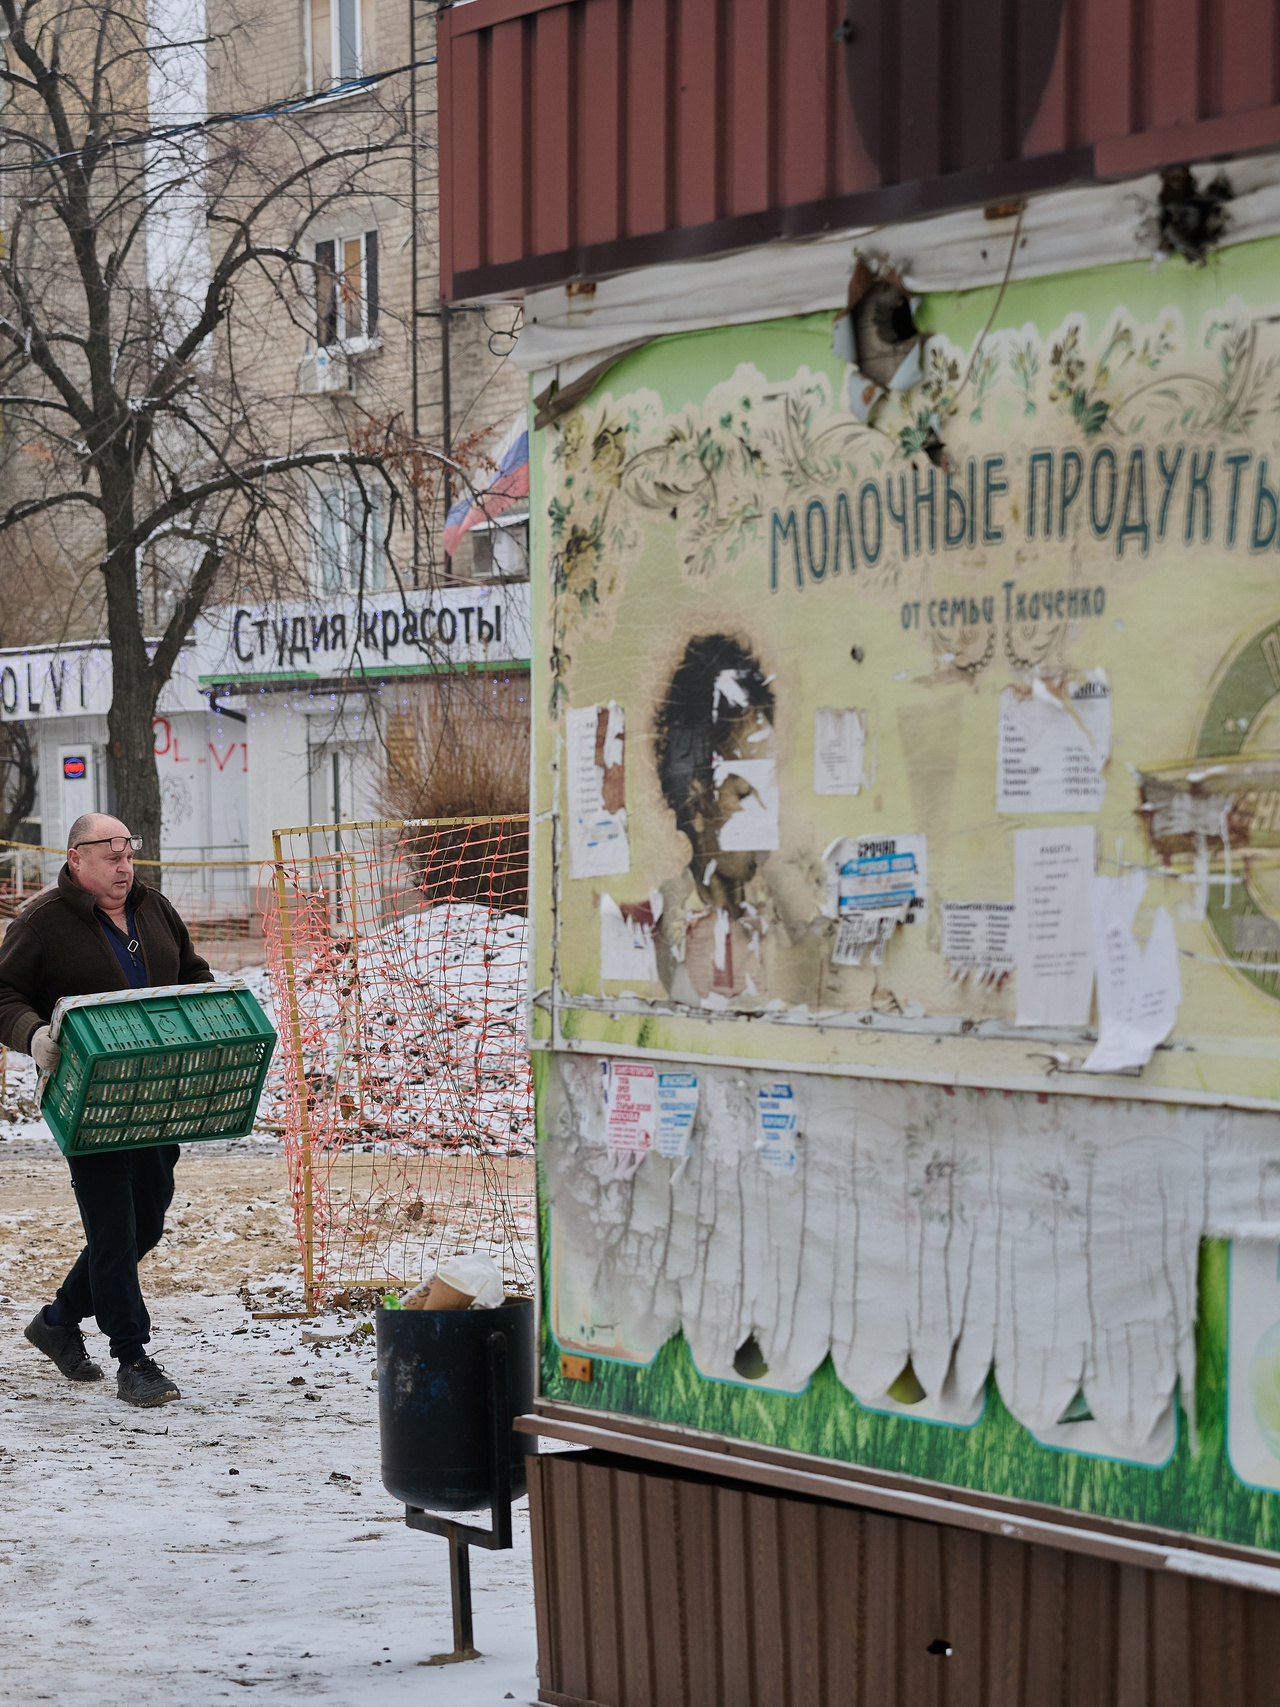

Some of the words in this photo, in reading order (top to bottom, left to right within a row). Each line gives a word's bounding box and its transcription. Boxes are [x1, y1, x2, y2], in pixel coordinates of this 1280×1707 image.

[767, 453, 1011, 593] МОЛОЧНЫЕ
[233, 609, 347, 667] Студия
[363, 604, 501, 661] красоты
[901, 602, 921, 630] от
[927, 596, 995, 628] семьи
[1001, 580, 1107, 622] Ткаченко
